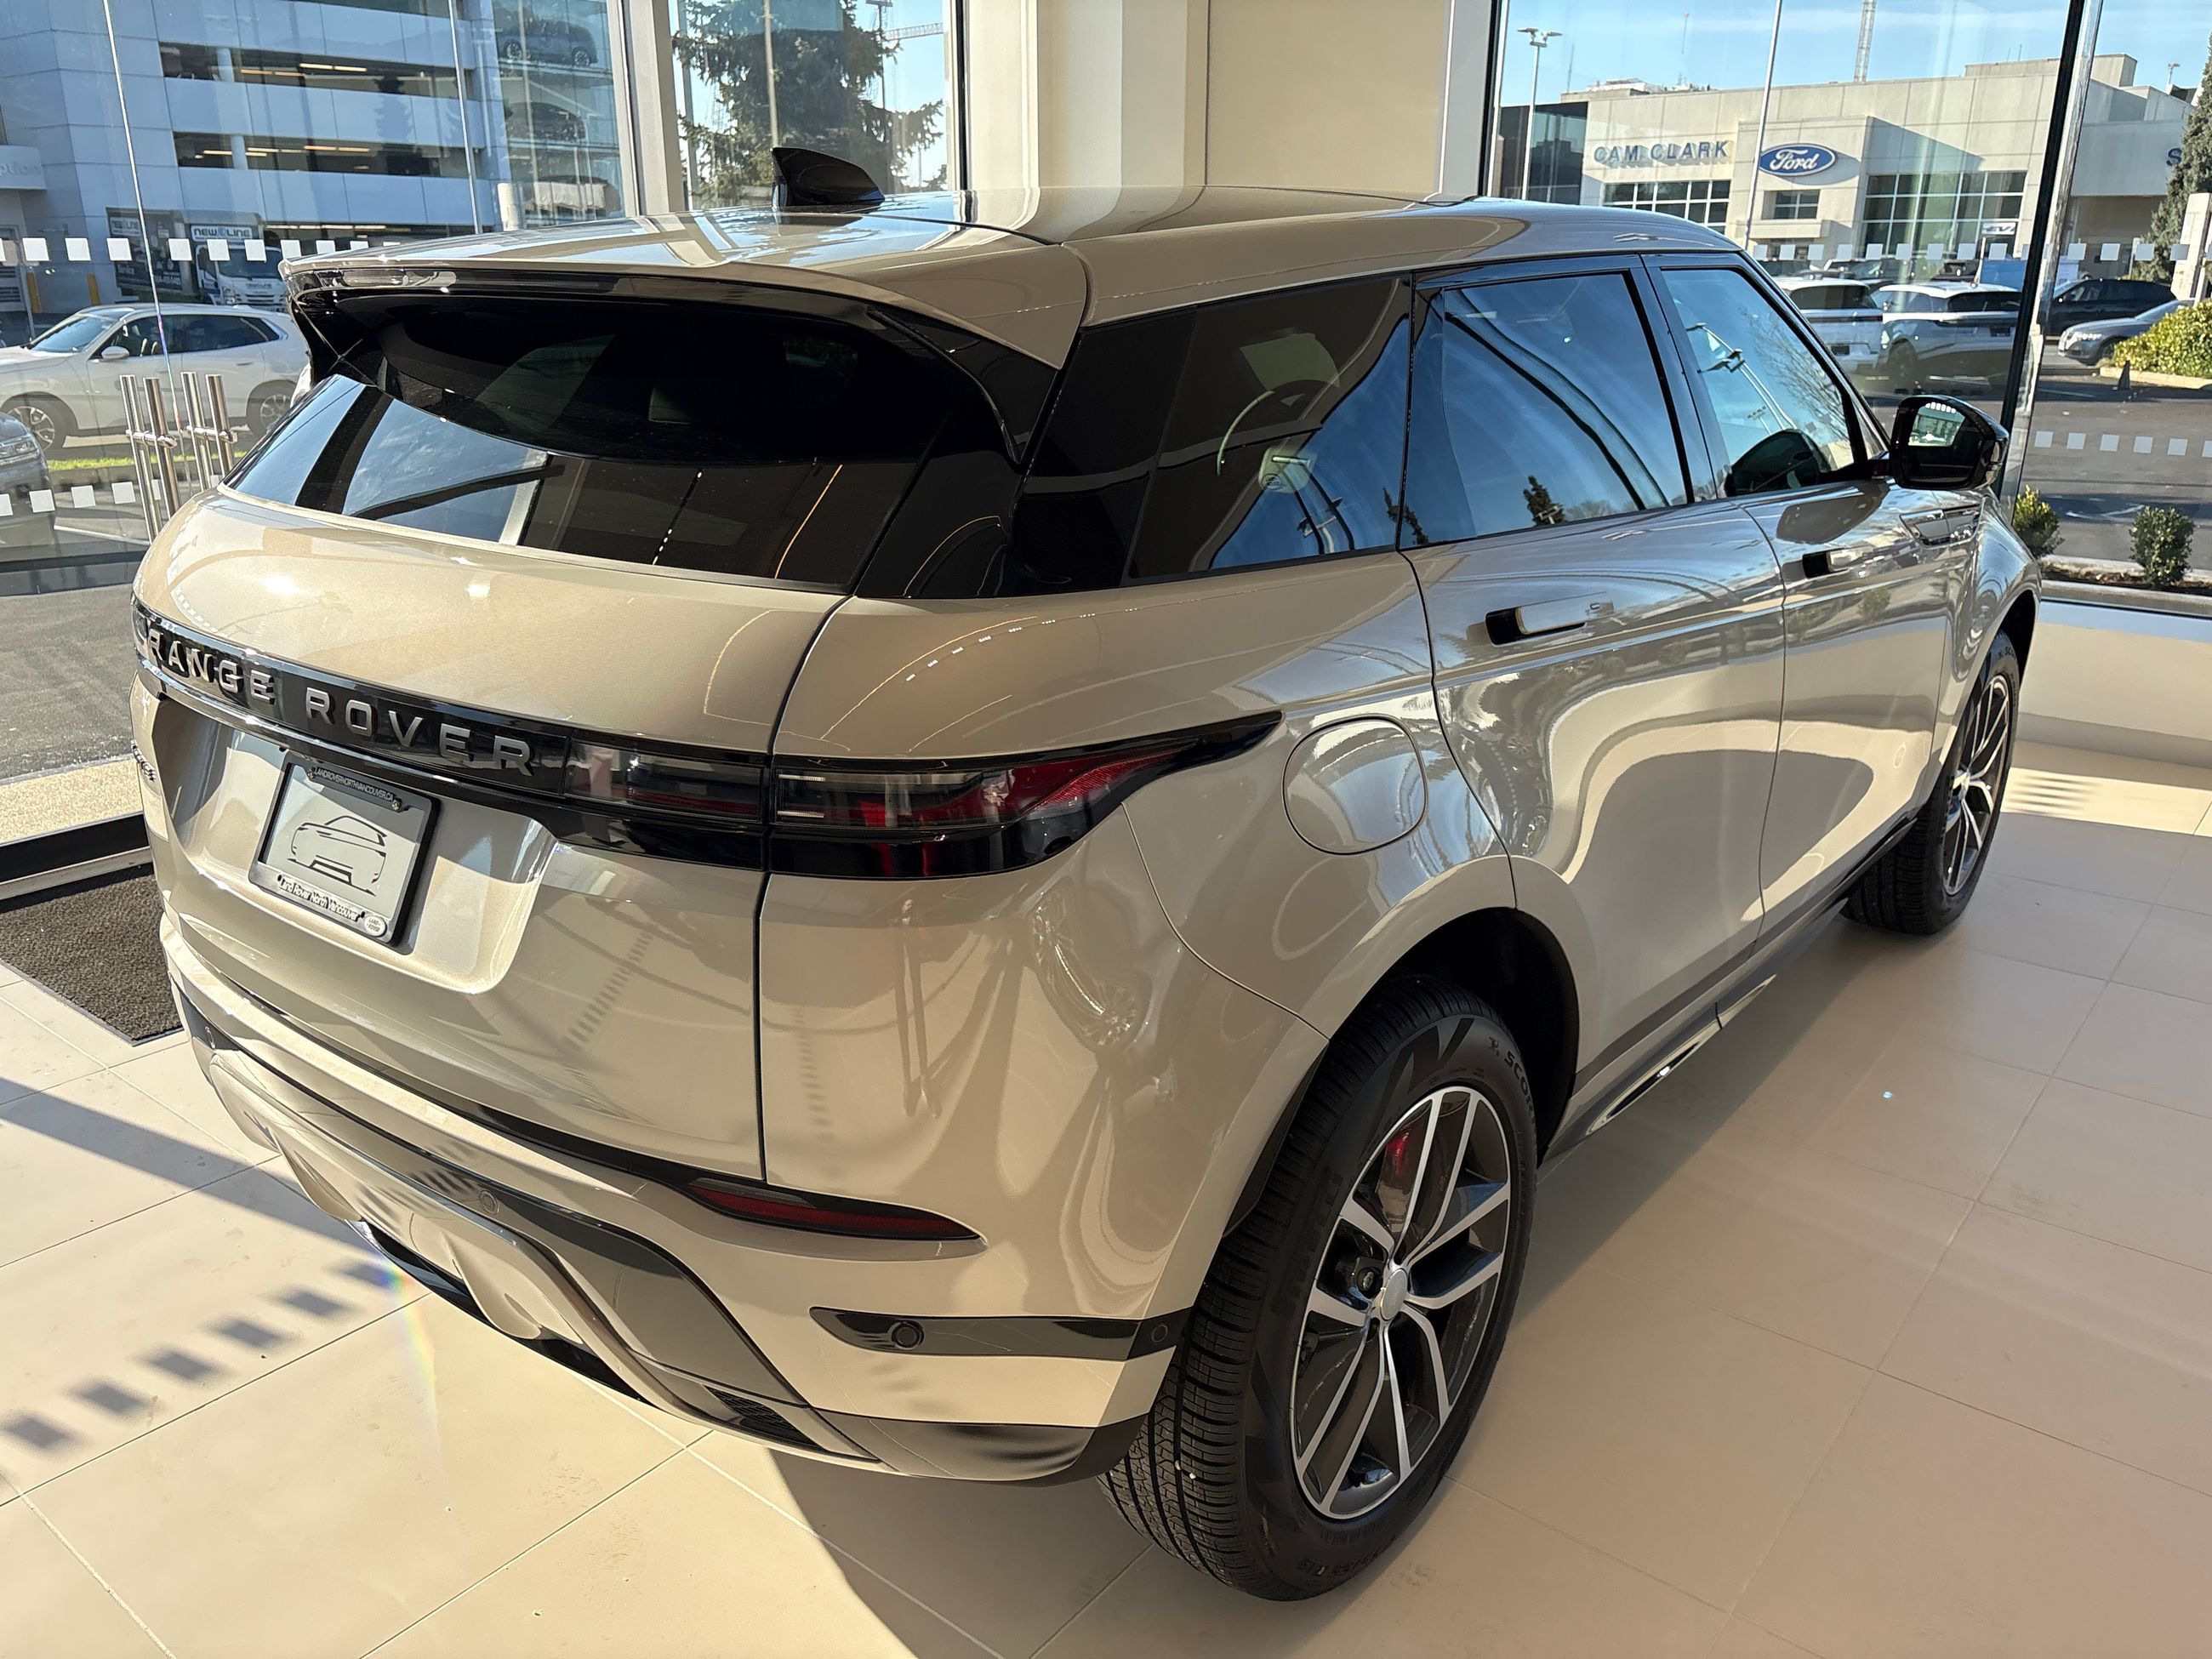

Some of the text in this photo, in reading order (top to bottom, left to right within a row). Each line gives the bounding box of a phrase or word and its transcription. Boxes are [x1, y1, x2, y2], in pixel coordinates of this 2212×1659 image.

[1593, 140, 1730, 162] CAM CLARK
[193, 227, 252, 238] NEW LINE
[148, 628, 276, 704] RANGE
[305, 687, 535, 777] ROVER
[279, 877, 358, 922] Land Rover North Vancouver
